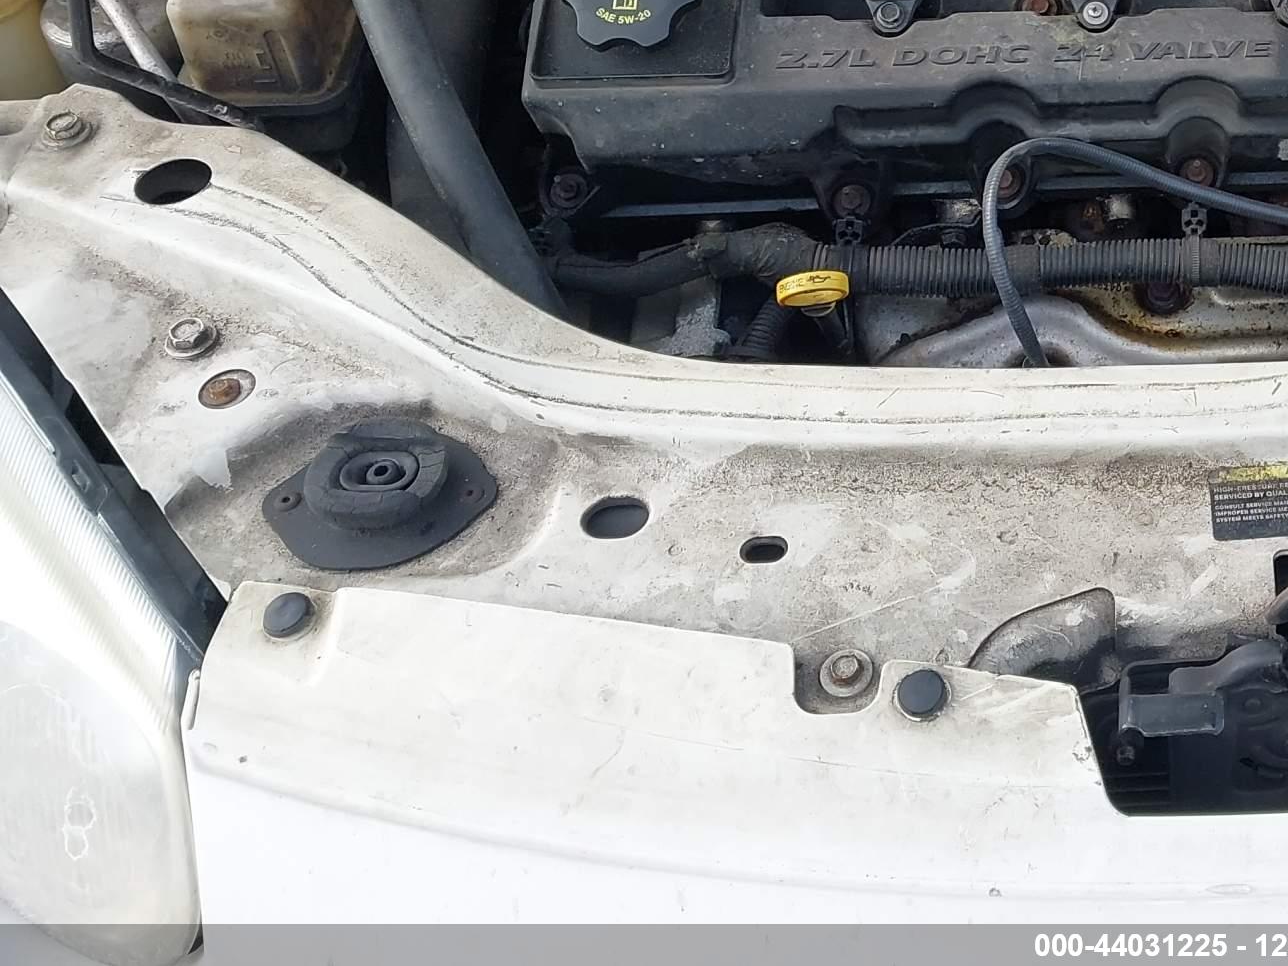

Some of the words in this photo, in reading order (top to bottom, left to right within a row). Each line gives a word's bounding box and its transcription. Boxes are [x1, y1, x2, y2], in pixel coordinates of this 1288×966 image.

[596, 7, 616, 23] SAE
[617, 9, 651, 24] 5W-20
[776, 48, 876, 70] 2.7L
[892, 45, 1030, 67] DOHC
[1053, 44, 1116, 64] 24
[1129, 40, 1274, 61] VALVE
[1214, 492, 1253, 500] SERVICED
[1215, 509, 1249, 517] IMPROPER
